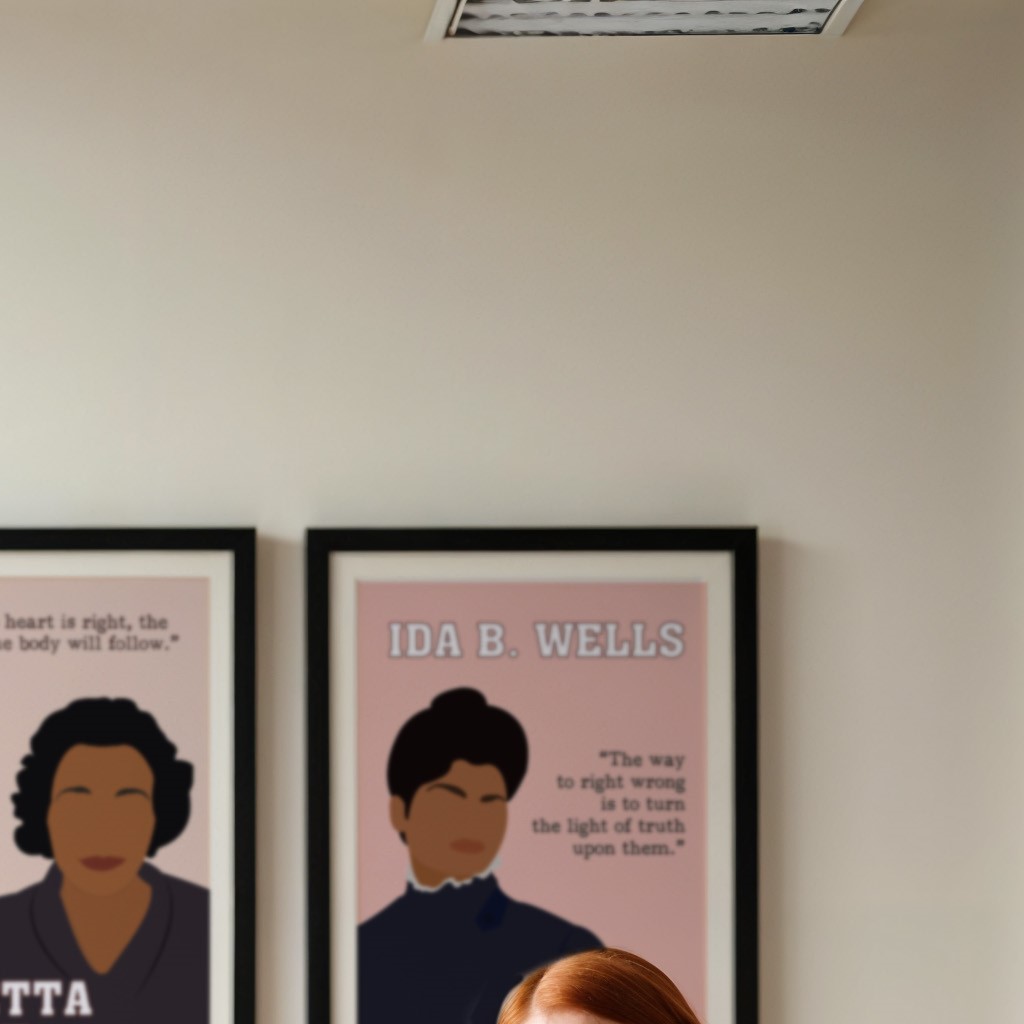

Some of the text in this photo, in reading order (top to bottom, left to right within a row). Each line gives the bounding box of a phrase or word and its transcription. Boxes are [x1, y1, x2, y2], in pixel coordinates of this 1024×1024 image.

[5, 613, 54, 630] heart
[61, 613, 75, 630] is
[82, 613, 132, 634] right,
[139, 613, 168, 630] the
[20, 635, 61, 654] body
[67, 635, 101, 651] will
[389, 622, 685, 659] IDA B. WELLS
[650, 754, 685, 771] way
[557, 773, 685, 793] to right wrong
[601, 796, 685, 811] is to turn
[532, 818, 685, 838] the light of truth
[573, 842, 615, 860] upon
